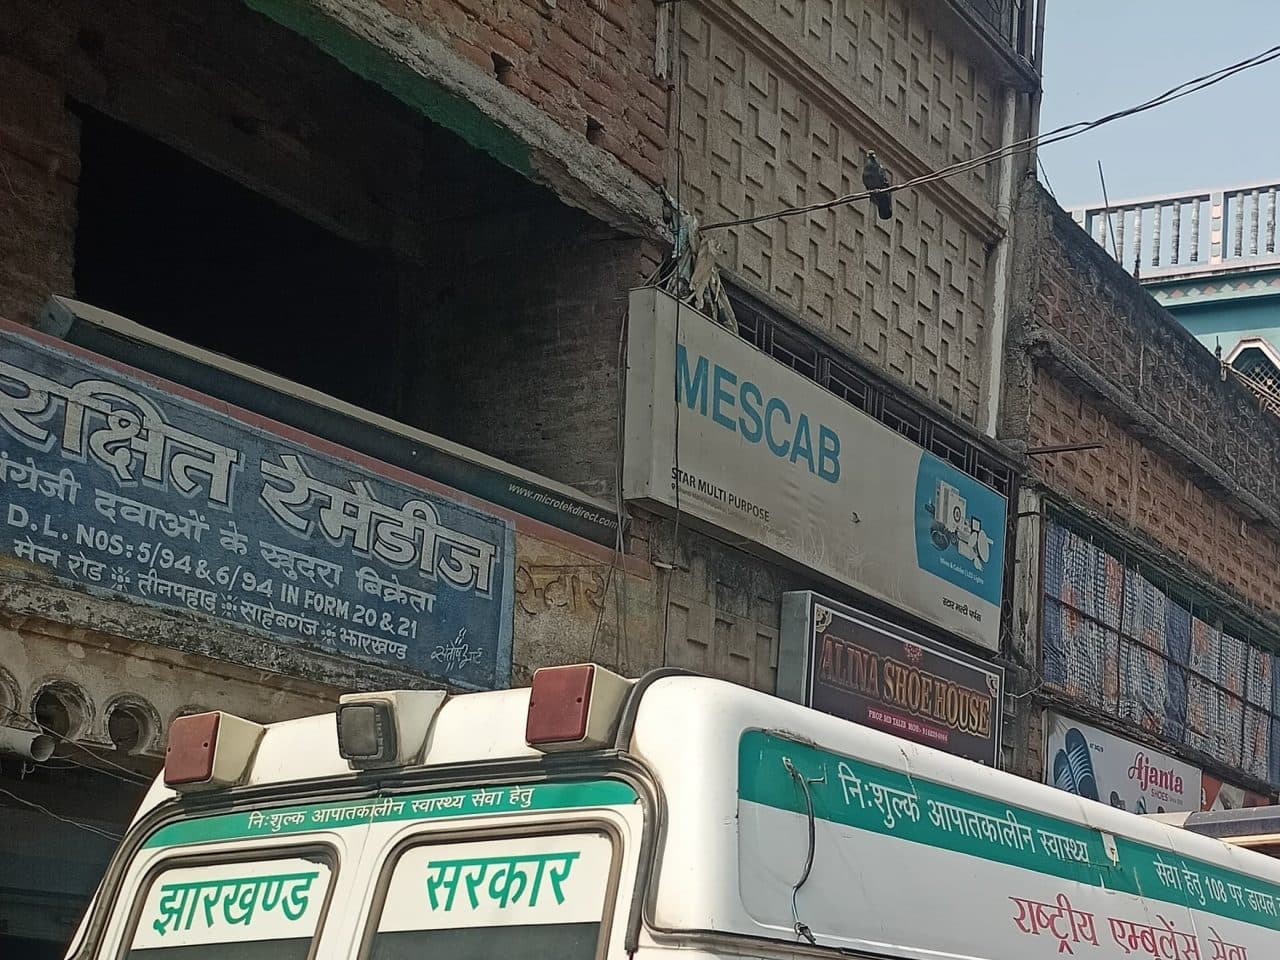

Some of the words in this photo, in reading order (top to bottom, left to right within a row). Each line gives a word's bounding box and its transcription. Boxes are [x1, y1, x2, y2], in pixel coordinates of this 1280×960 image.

[675, 343, 841, 484] MESCAB
[508, 483, 618, 529] www.microtekdirect.com
[672, 467, 696, 488] STAR
[698, 479, 727, 503] MULTI
[729, 493, 770, 522] PURPOSE
[68, 550, 107, 581] रोड
[95, 488, 210, 543] दवाओं
[219, 520, 249, 556] के
[259, 540, 344, 588] खुदरा
[281, 583, 299, 606] IN
[305, 590, 349, 620] FORM
[821, 637, 880, 698] ALINA
[883, 657, 933, 719] SHOE
[935, 680, 992, 735] HOUSE
[1128, 752, 1184, 795] Ajanta
[311, 797, 404, 823] आपातकालीन
[411, 794, 466, 813] स्वास्थ्य
[471, 788, 503, 807] सेवा
[509, 785, 536, 807] हेतु
[927, 799, 1036, 853] आपातकालीन
[1153, 853, 1182, 891] सेवा
[1182, 860, 1206, 905] हेतु
[1205, 876, 1228, 903] 108
[1227, 882, 1246, 908] पर
[1245, 888, 1279, 917] डायल
[153, 871, 319, 935] झारखण्ड
[426, 850, 580, 912] सरकार
[1008, 892, 1100, 954] राष्ट्रीय
